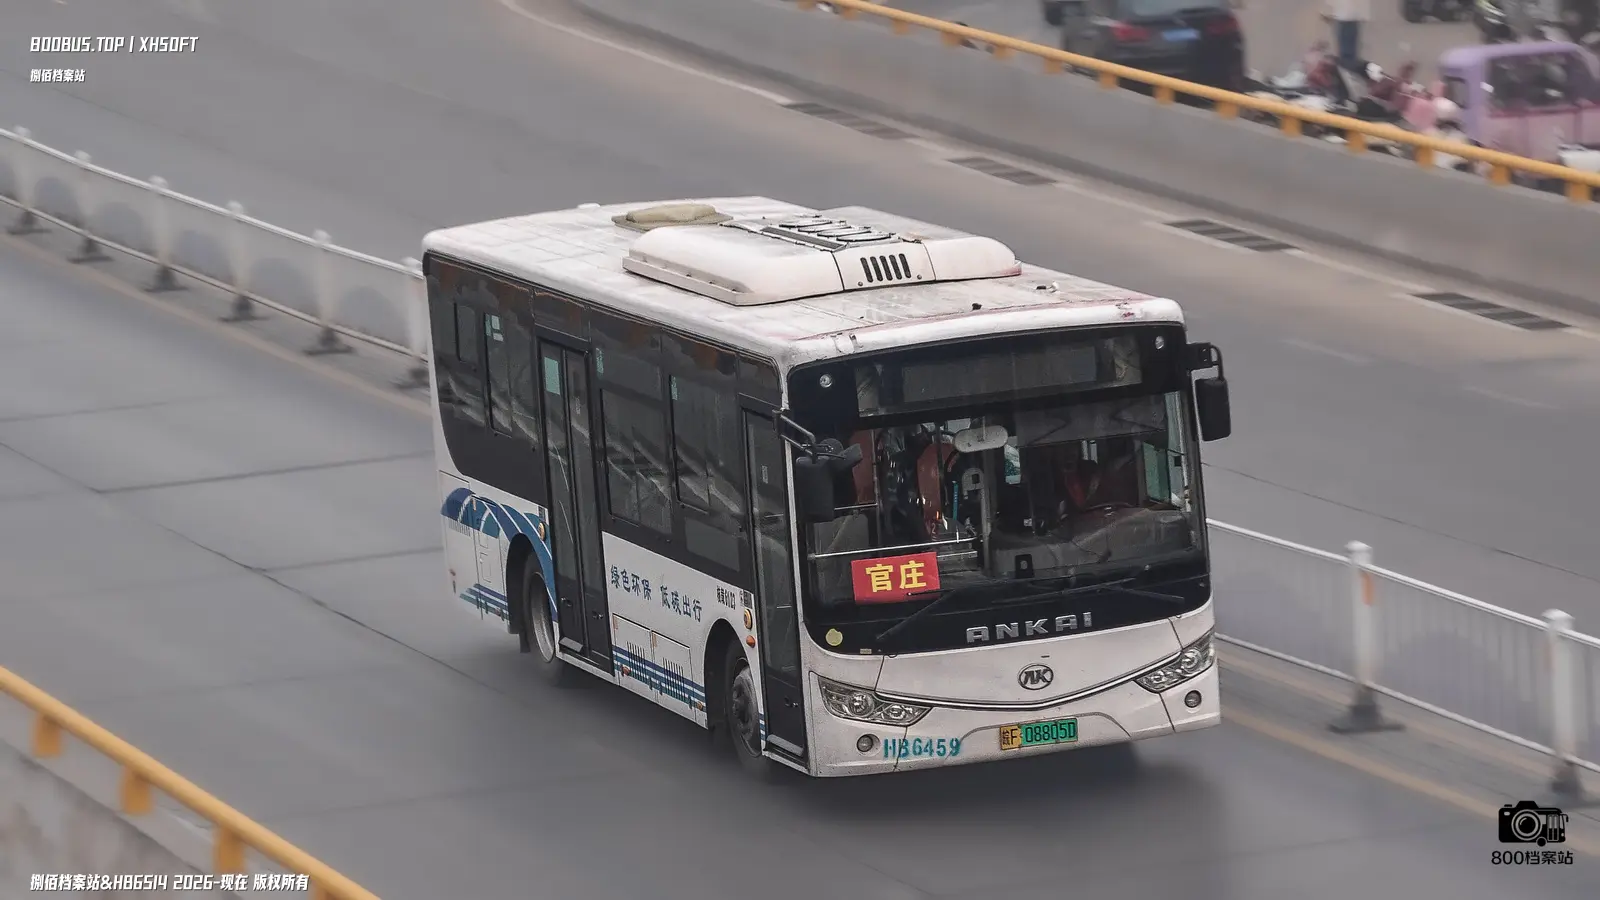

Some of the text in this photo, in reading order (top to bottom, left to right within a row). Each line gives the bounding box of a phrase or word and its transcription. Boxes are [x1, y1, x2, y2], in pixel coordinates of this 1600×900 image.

[865, 560, 927, 593] 官庄
[610, 564, 652, 601] 绿色环保
[660, 585, 703, 623] 低碳出行
[966, 611, 1092, 643] ANKAI
[883, 738, 961, 758] HB6459
